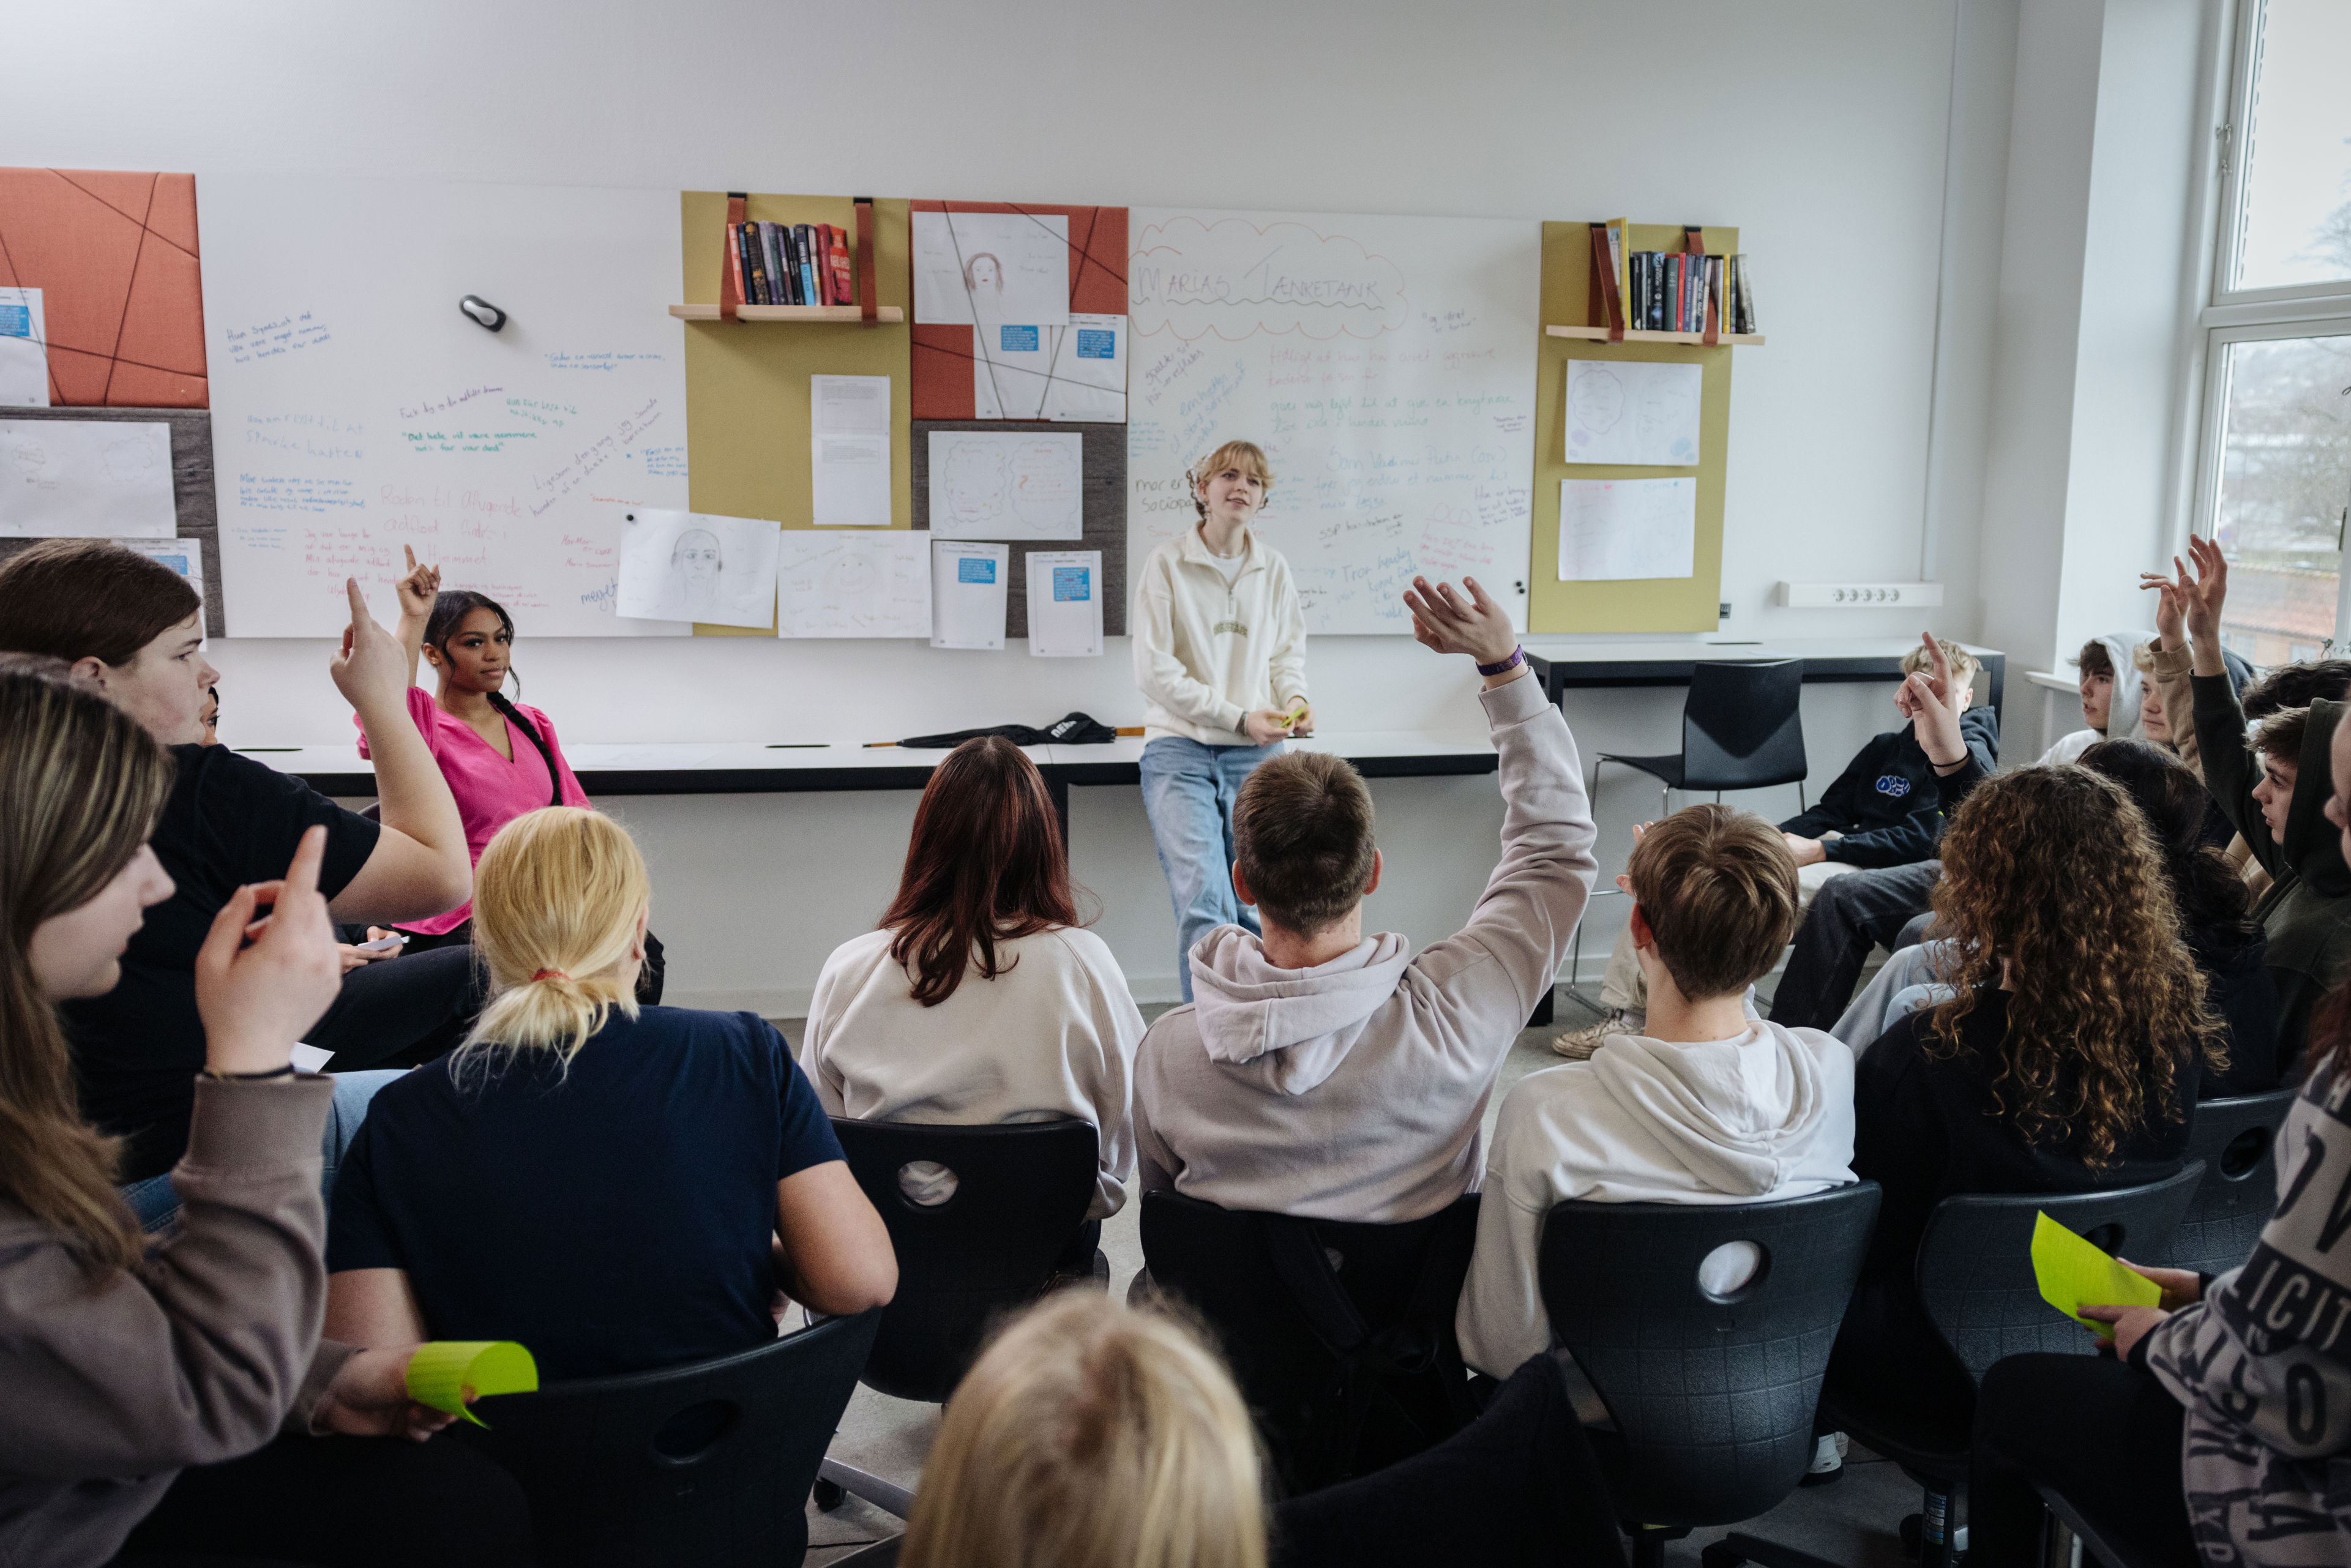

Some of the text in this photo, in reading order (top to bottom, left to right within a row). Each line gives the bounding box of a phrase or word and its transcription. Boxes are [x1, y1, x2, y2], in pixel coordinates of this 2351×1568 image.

[1138, 245, 1383, 306] MARIAS TÆNKETANK
[1385, 397, 1398, 408] at
[399, 407, 419, 419] Fuck
[1135, 478, 1184, 493] mor er
[1142, 496, 1195, 515] Sociopa
